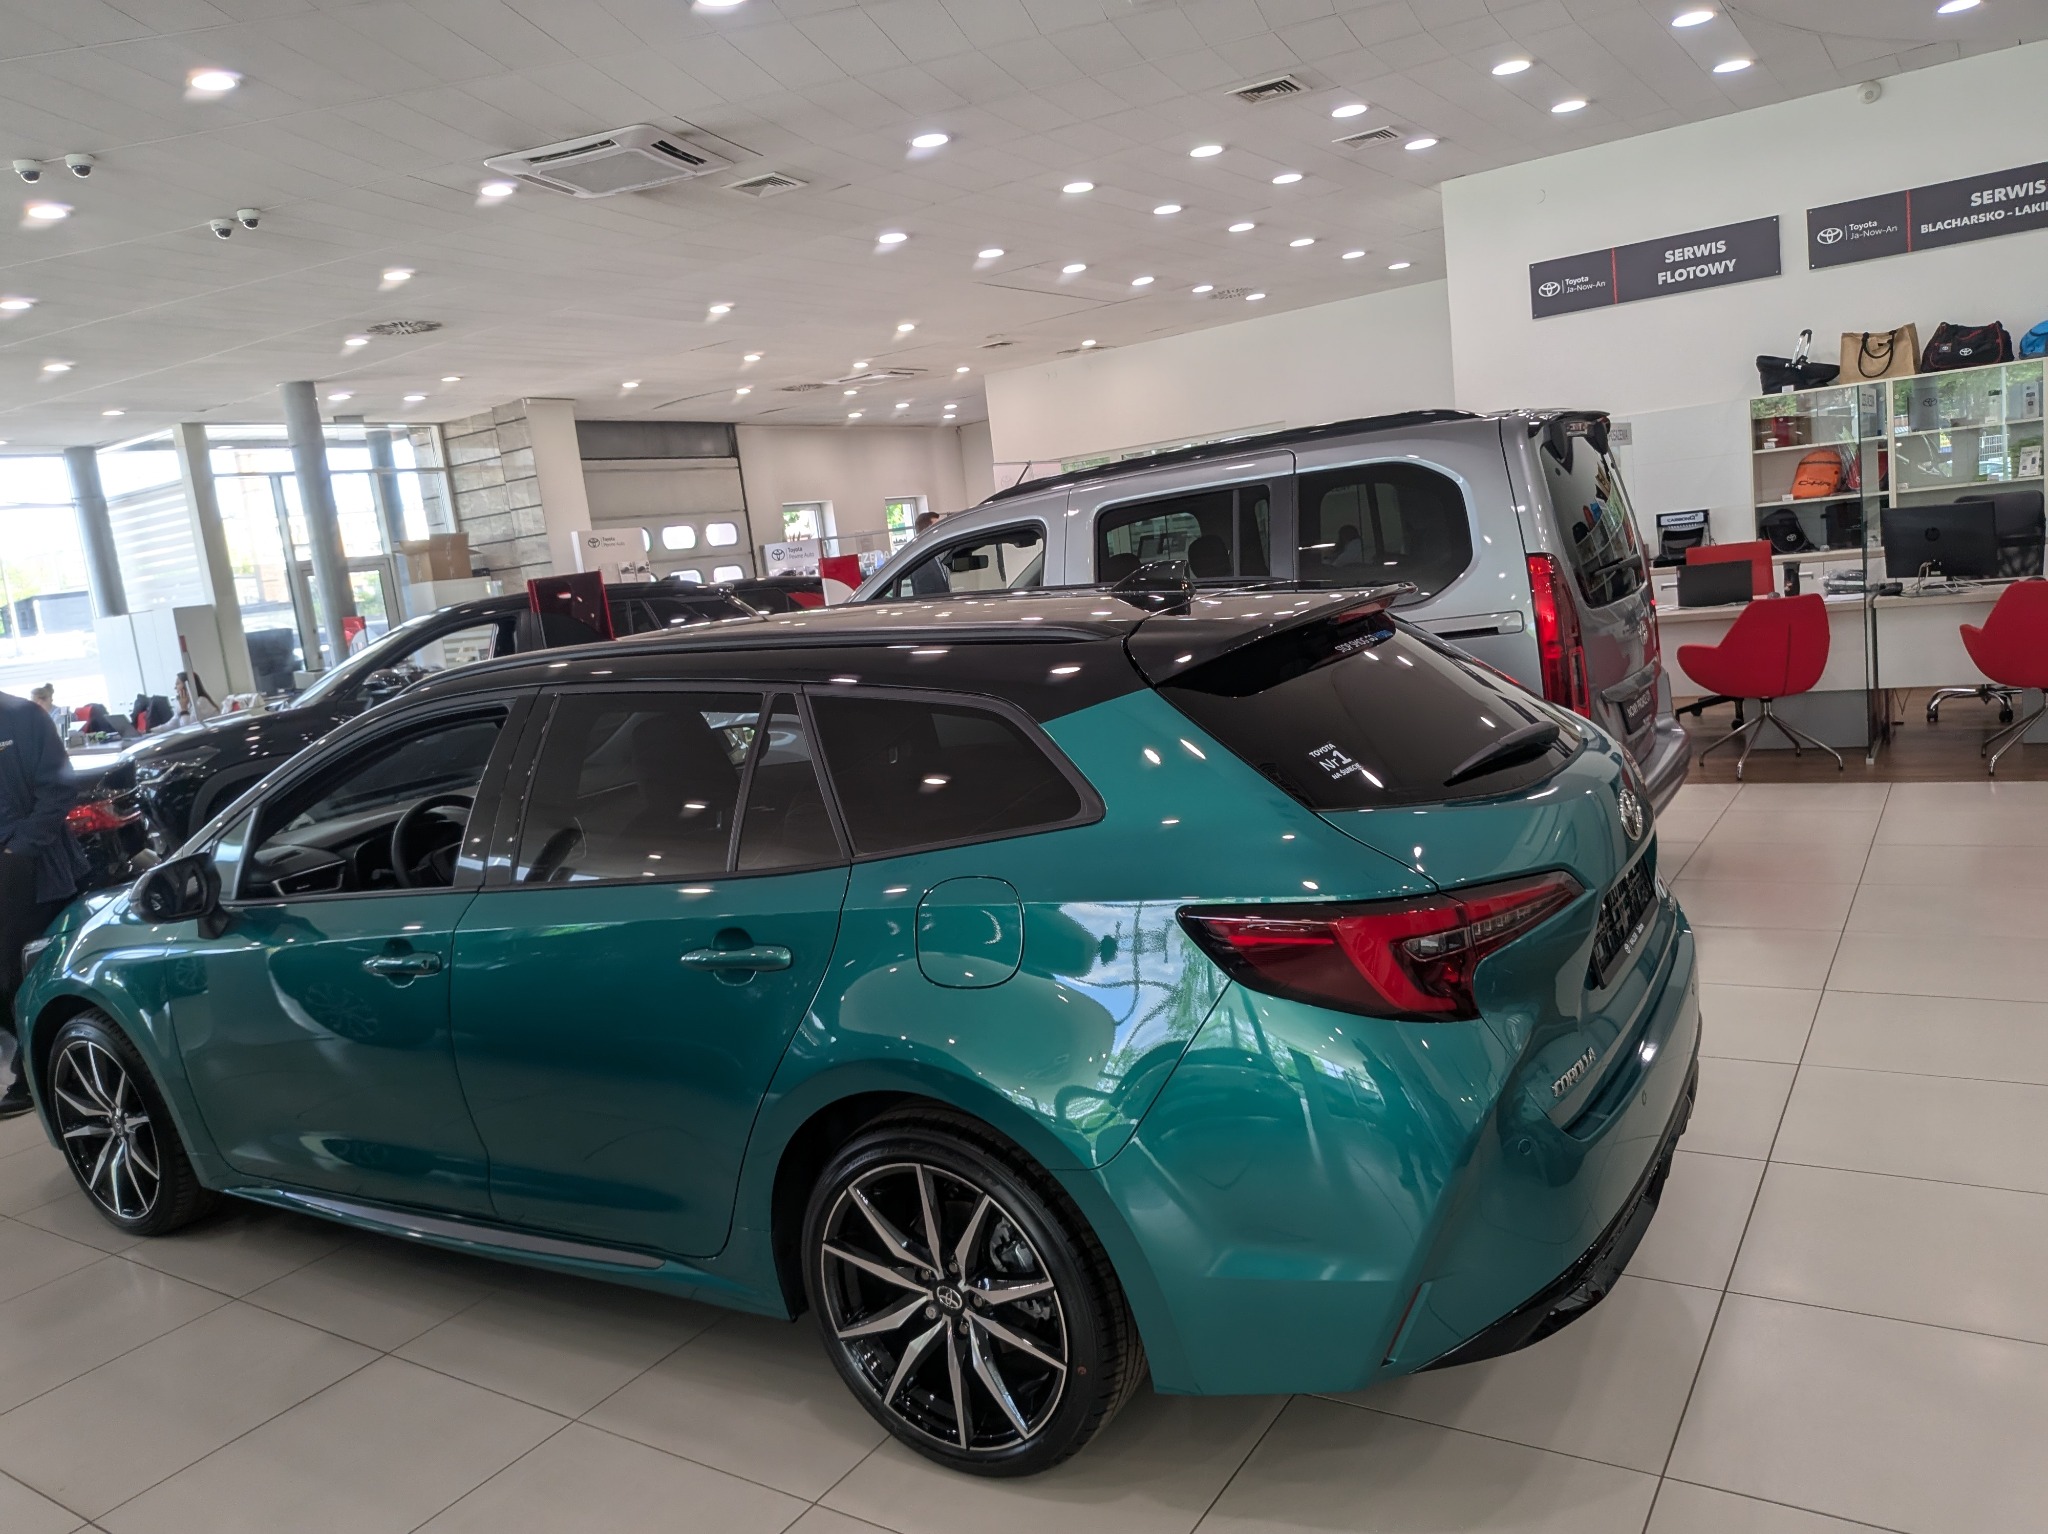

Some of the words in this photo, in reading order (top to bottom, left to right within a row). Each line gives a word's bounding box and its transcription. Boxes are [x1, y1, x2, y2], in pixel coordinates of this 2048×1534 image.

[1970, 178, 2046, 207] SERWIS
[1849, 220, 1878, 231] Toyota
[1920, 209, 2005, 234] BLACHARSKO
[1850, 225, 1898, 240] Ja-Now-An
[1664, 240, 1727, 264] SERWIS
[1657, 258, 1737, 286] FLOTOWY
[1564, 275, 1590, 287] Toyota
[1565, 280, 1606, 294] Ja-Now-An
[1308, 743, 1336, 758] TOYOTA
[1332, 750, 1353, 765] 1
[1550, 1046, 1597, 1098] COROLLA
